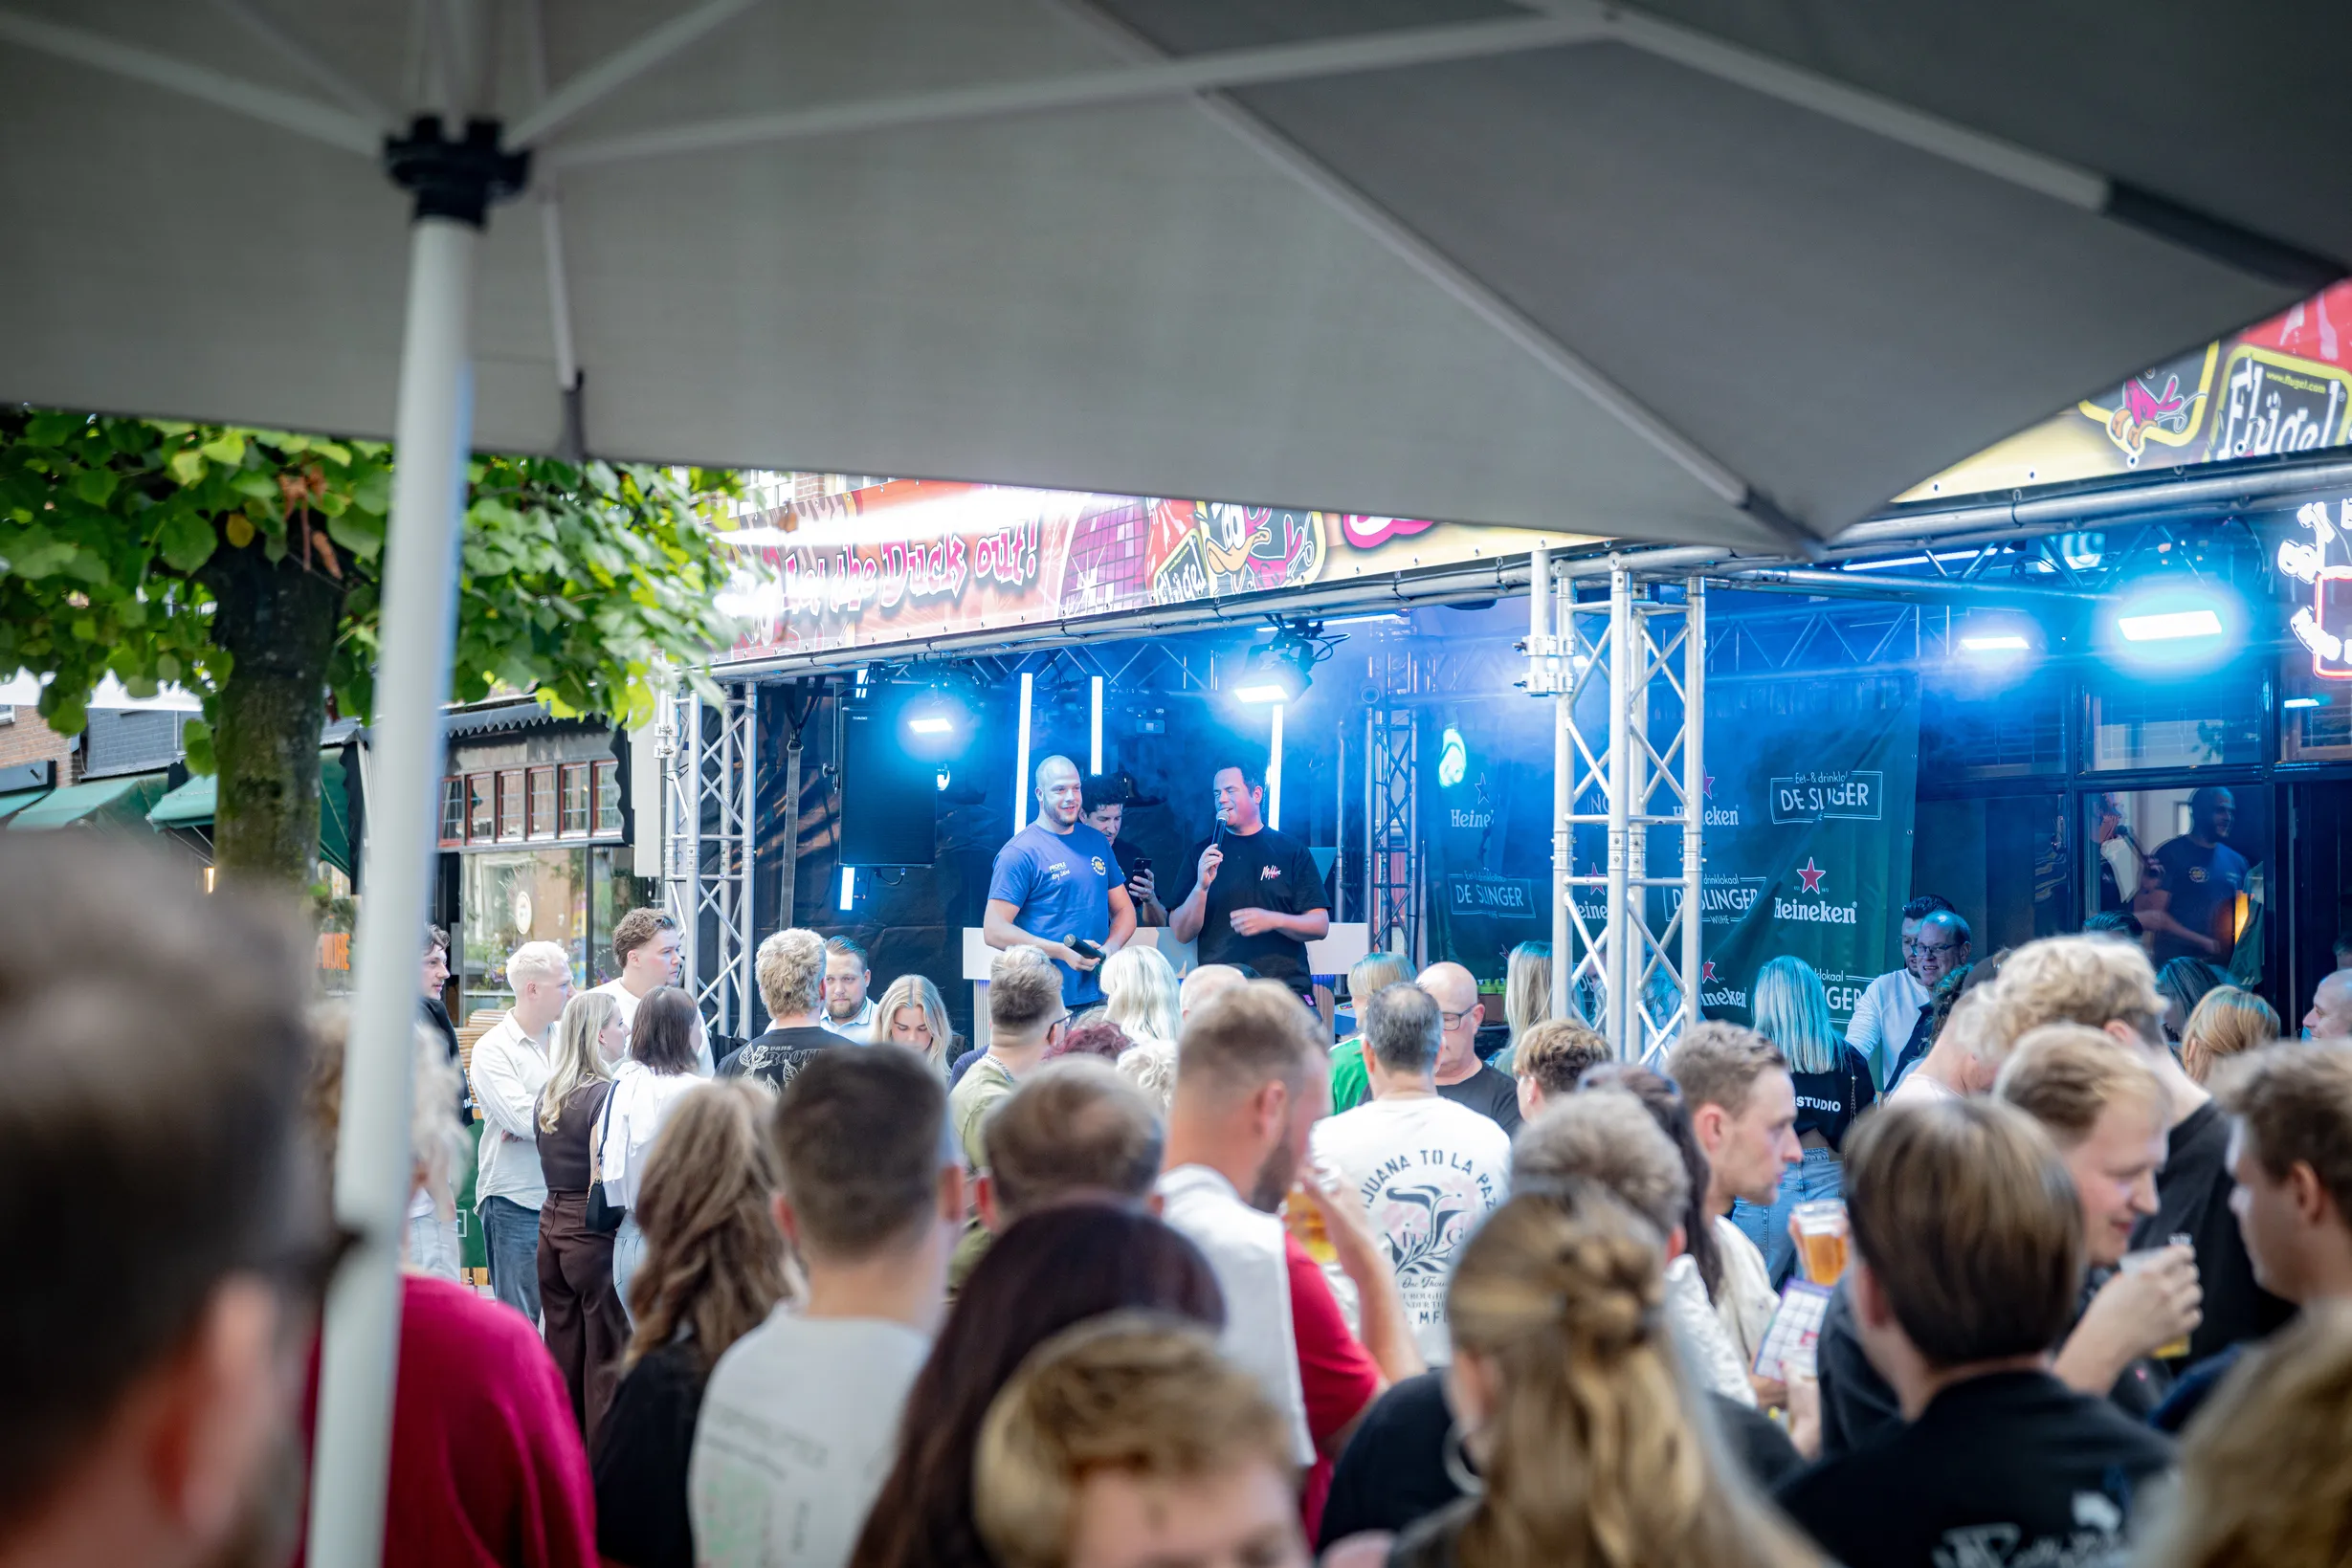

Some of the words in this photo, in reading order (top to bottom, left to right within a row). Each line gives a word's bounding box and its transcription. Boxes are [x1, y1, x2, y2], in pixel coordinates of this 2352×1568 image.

[830, 542, 878, 613] the
[880, 532, 968, 607] Duck
[975, 519, 1039, 586] out!
[1781, 789, 1805, 811] DE
[1455, 884, 1473, 903] DE
[1774, 897, 1856, 924] Heineken
[1420, 1150, 1443, 1164] TO
[1451, 1153, 1473, 1175] LA
[1476, 1173, 1497, 1210] PAZ
